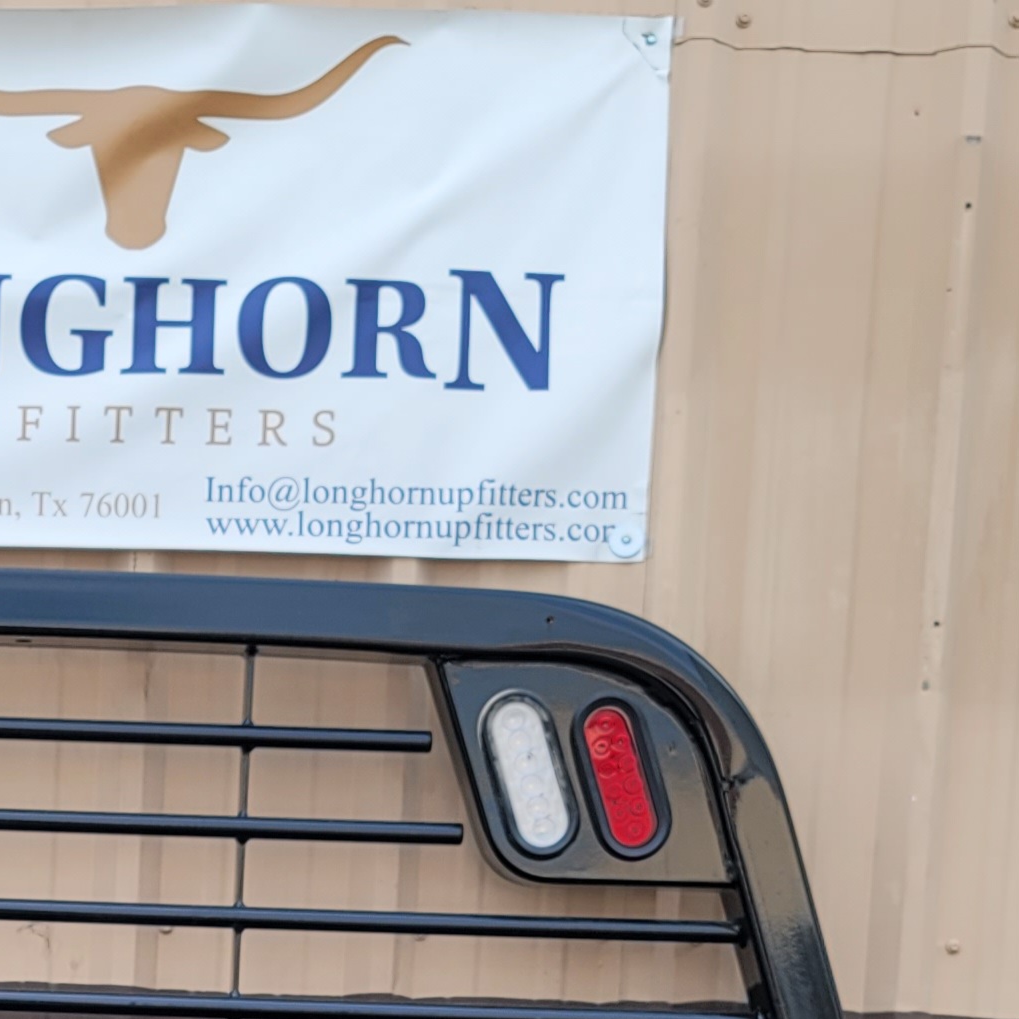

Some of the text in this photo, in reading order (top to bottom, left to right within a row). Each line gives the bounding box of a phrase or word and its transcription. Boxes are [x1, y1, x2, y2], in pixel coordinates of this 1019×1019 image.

[31, 490, 69, 518] Tx
[80, 491, 162, 519] 76001
[204, 475, 628, 512] Info@longhornupfitters.com
